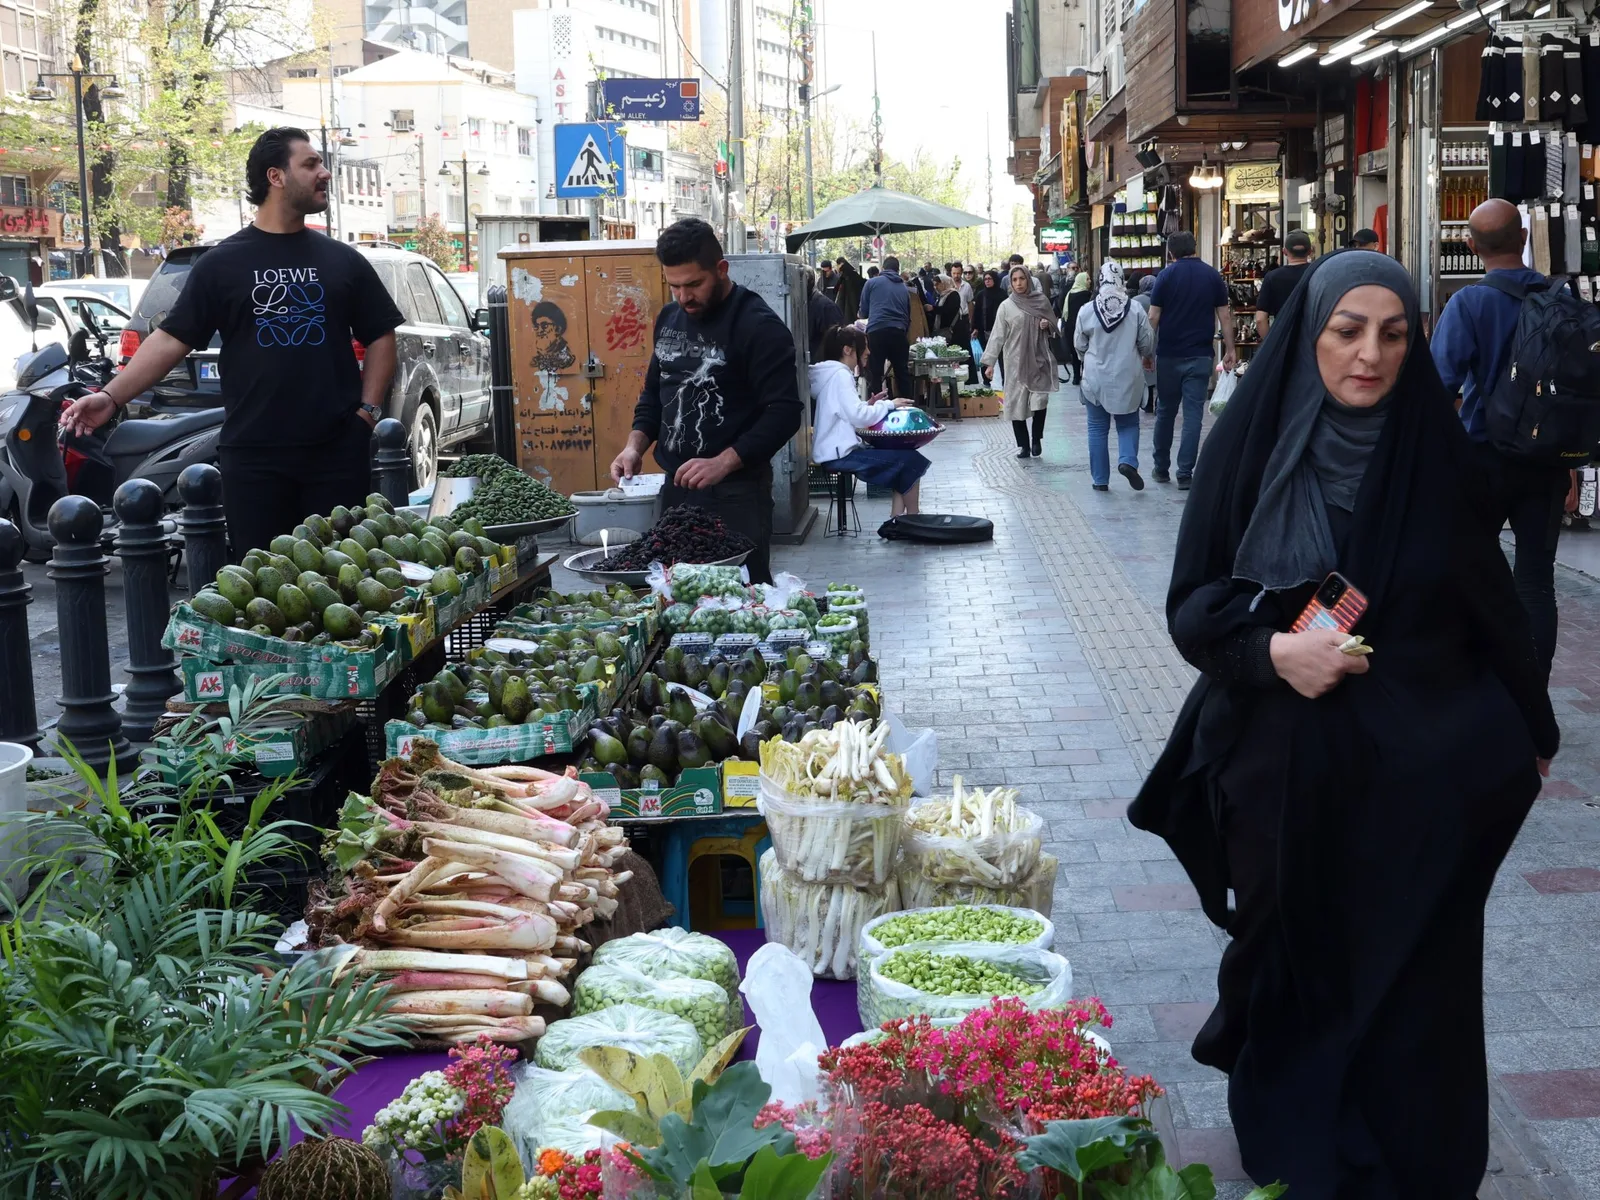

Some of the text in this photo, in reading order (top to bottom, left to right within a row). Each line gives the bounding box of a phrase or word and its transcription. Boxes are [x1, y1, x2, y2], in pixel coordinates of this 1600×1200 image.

[665, 81, 678, 89] کوچه
[621, 89, 666, 109] زعیم
[253, 267, 319, 284] LOEWE
[199, 675, 223, 694] AK
